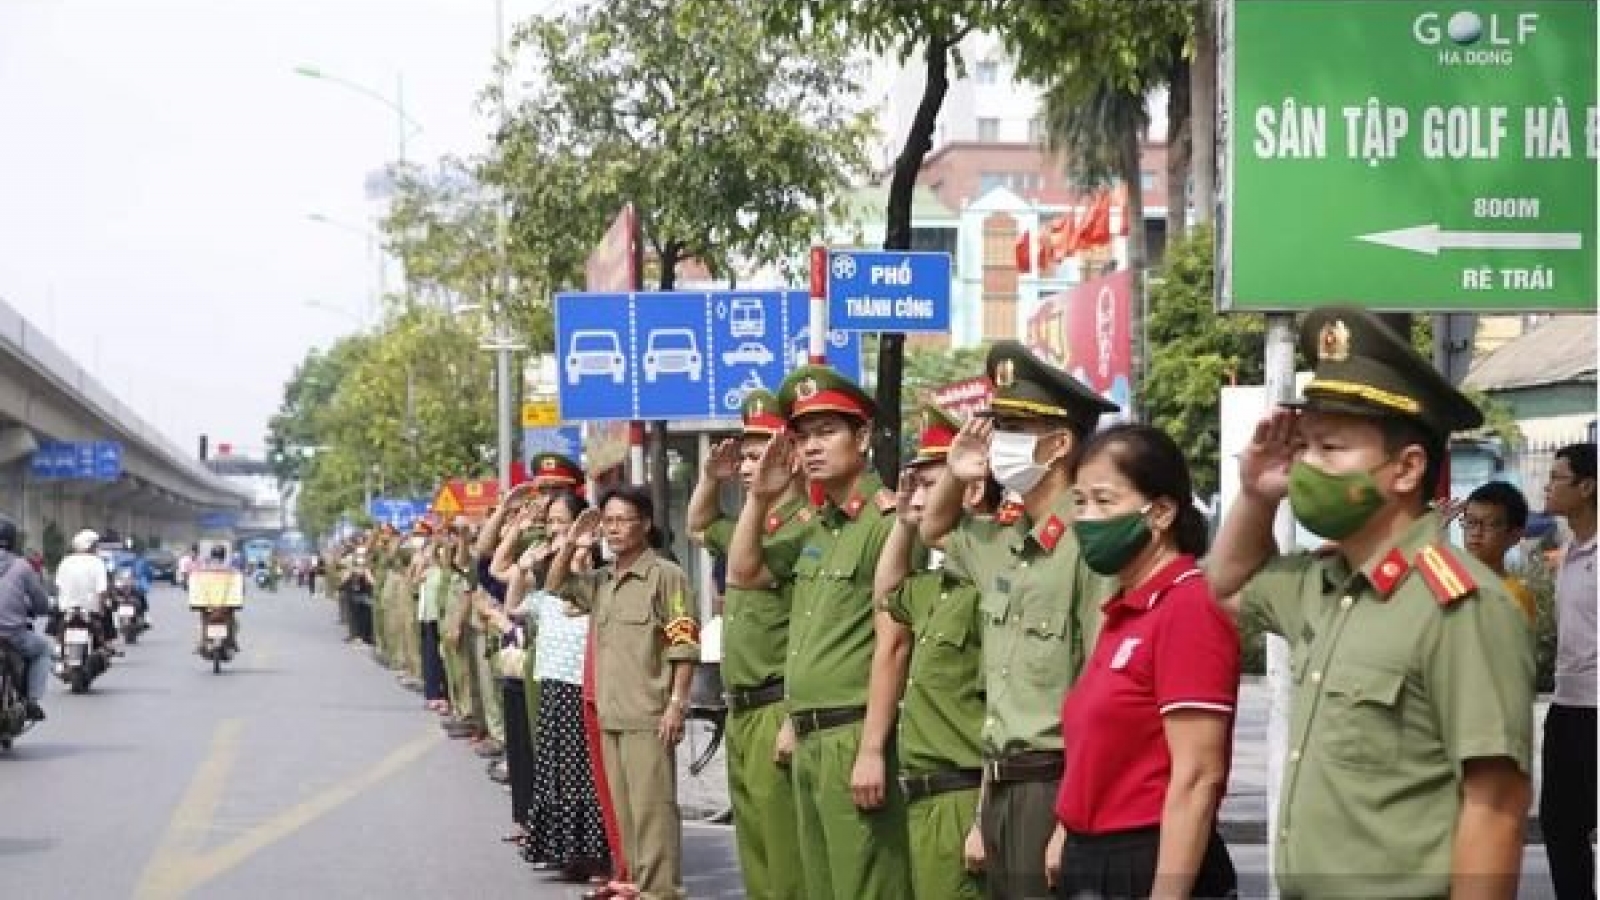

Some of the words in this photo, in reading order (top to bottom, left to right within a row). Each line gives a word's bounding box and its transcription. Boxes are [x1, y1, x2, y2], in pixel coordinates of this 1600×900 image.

[1413, 11, 1539, 45] GOLF
[1253, 97, 1327, 159] SÂN
[1343, 97, 1409, 167] TẬP
[1423, 106, 1508, 159] GOLF
[1524, 96, 1572, 159] HÀ
[1474, 197, 1540, 219] 800M
[1499, 264, 1554, 290] TRÁI
[846, 295, 892, 318] THÀNH
[895, 295, 934, 319] CÔNG
